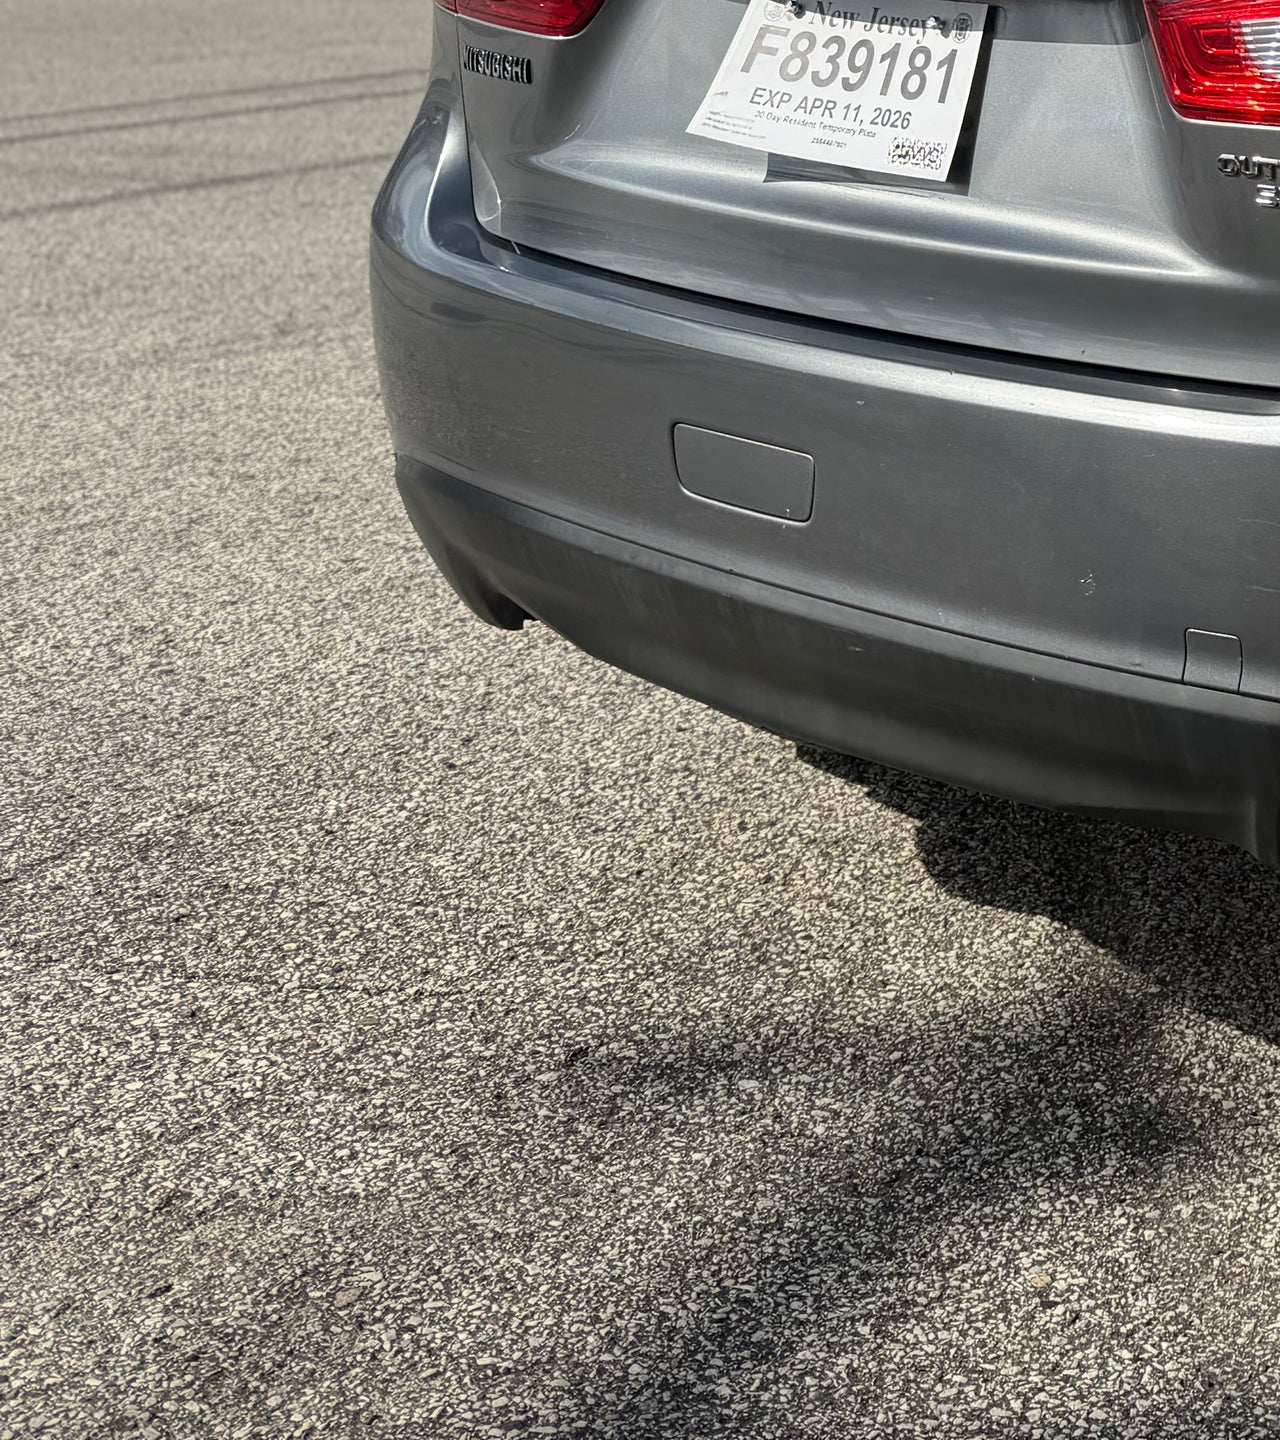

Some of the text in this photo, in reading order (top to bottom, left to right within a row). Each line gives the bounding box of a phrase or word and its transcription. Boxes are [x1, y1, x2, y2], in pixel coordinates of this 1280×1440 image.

[808, 0, 930, 45] New Jersey
[463, 46, 531, 83] MITSUBISHI
[740, 23, 958, 104] F839181
[750, 87, 912, 130] EXP APR 11, 2026
